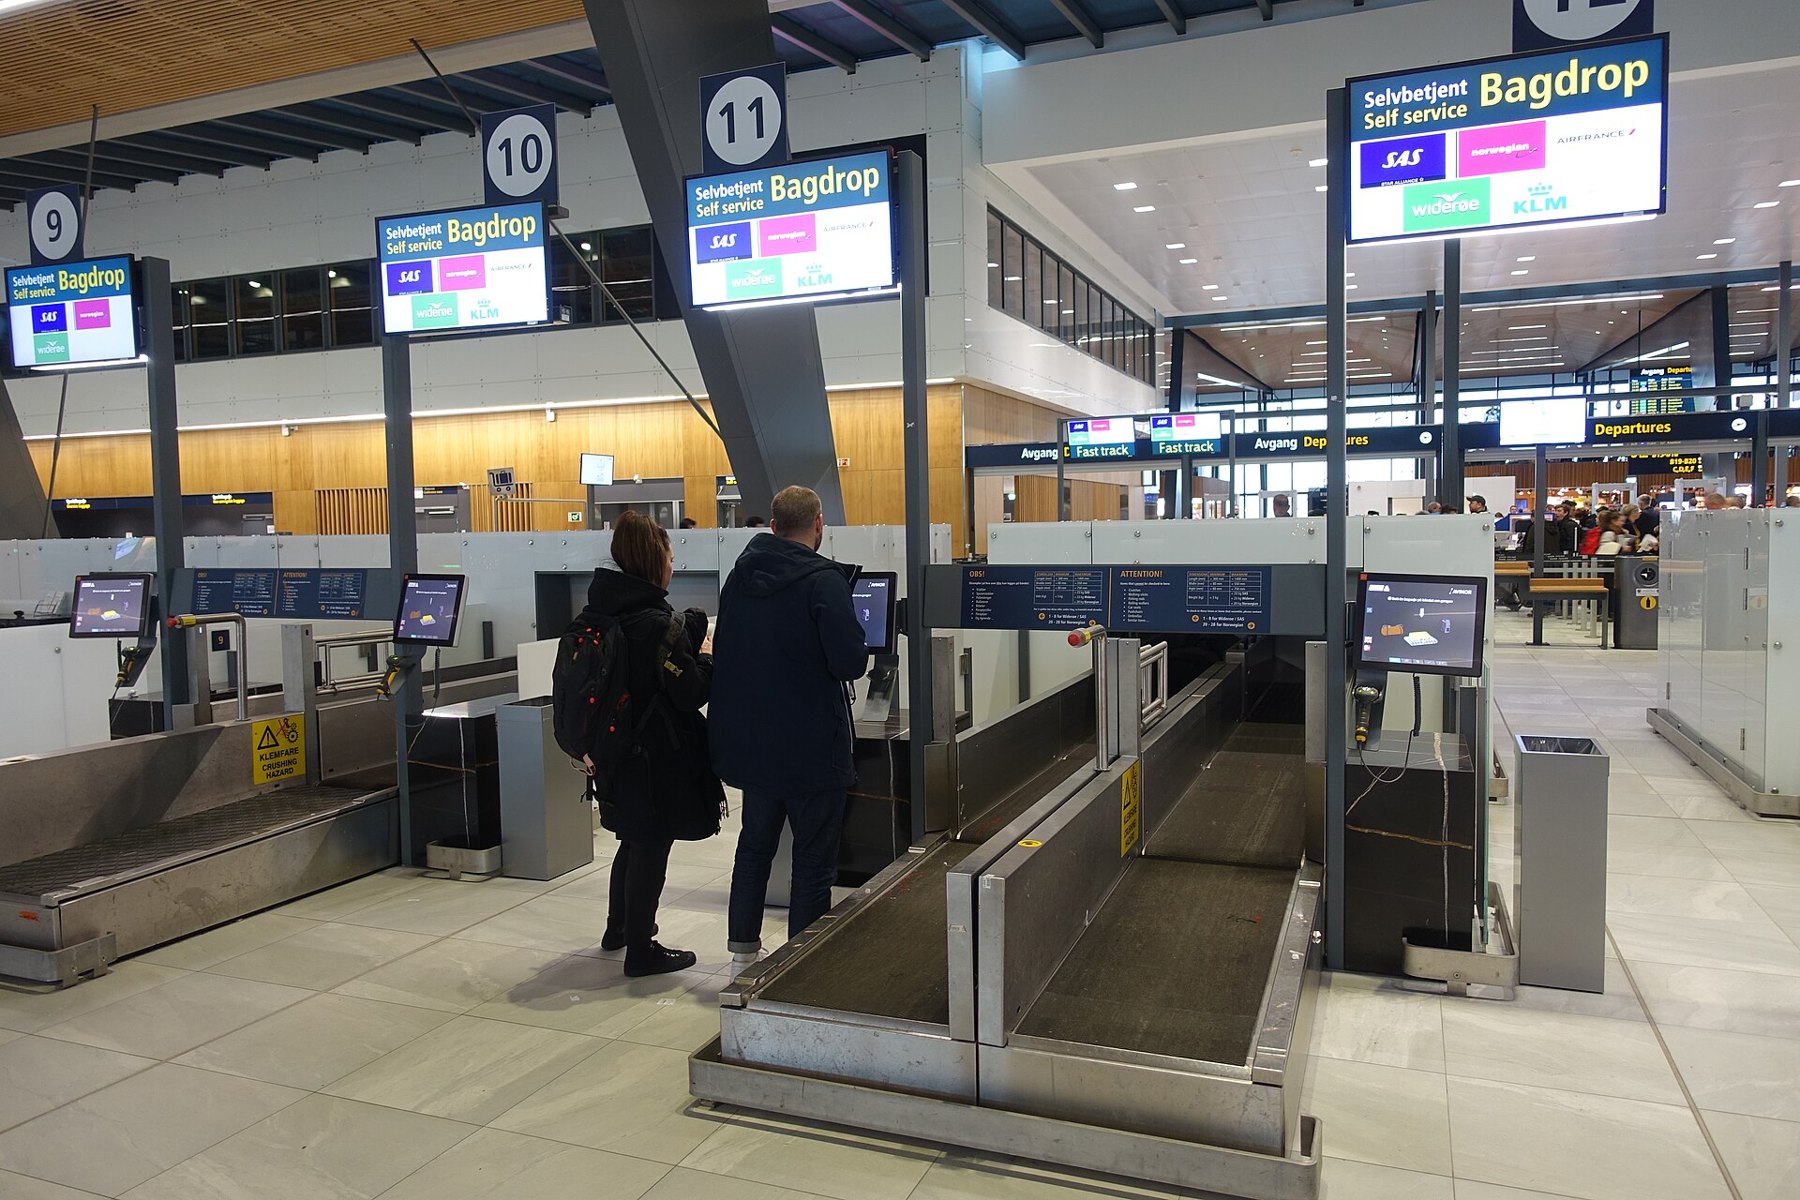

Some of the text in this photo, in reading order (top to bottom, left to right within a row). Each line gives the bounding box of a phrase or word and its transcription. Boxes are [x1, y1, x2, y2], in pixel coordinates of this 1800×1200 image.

[1364, 58, 1649, 110] Selvbetjent Bagdrop
[719, 97, 764, 143] 11
[1364, 102, 1468, 130] Self service
[498, 133, 543, 177] 10
[1472, 143, 1529, 158] norwegian
[1382, 149, 1424, 169] SAS
[696, 166, 879, 204] Selvbetjent Bagdrop
[696, 198, 764, 217] Self service
[1513, 196, 1566, 214] KLM
[46, 210, 62, 242] 9
[386, 213, 536, 246] Selvbetjent Bagdrop
[387, 238, 442, 255] Self service
[710, 233, 737, 249] SAS
[13, 265, 125, 294] Selvbetjent Bagdrop
[398, 270, 421, 284] SAS
[797, 274, 832, 287] KLM
[14, 286, 55, 300] Self service
[40, 311, 58, 323] SAS
[470, 308, 499, 320] KLM
[1667, 366, 1692, 375] Departu
[1595, 422, 1671, 438] Departures
[1076, 446, 1099, 458] Fast
[1100, 443, 1129, 456] track
[1159, 439, 1214, 454] Fast track
[1255, 435, 1369, 451] Avgang Depures
[1021, 447, 1058, 460] Avgang
[218, 636, 224, 644] 9
[260, 746, 299, 761] KLEMFARE
[262, 758, 297, 772] CRUSHING
[266, 767, 294, 779] HAZARD
